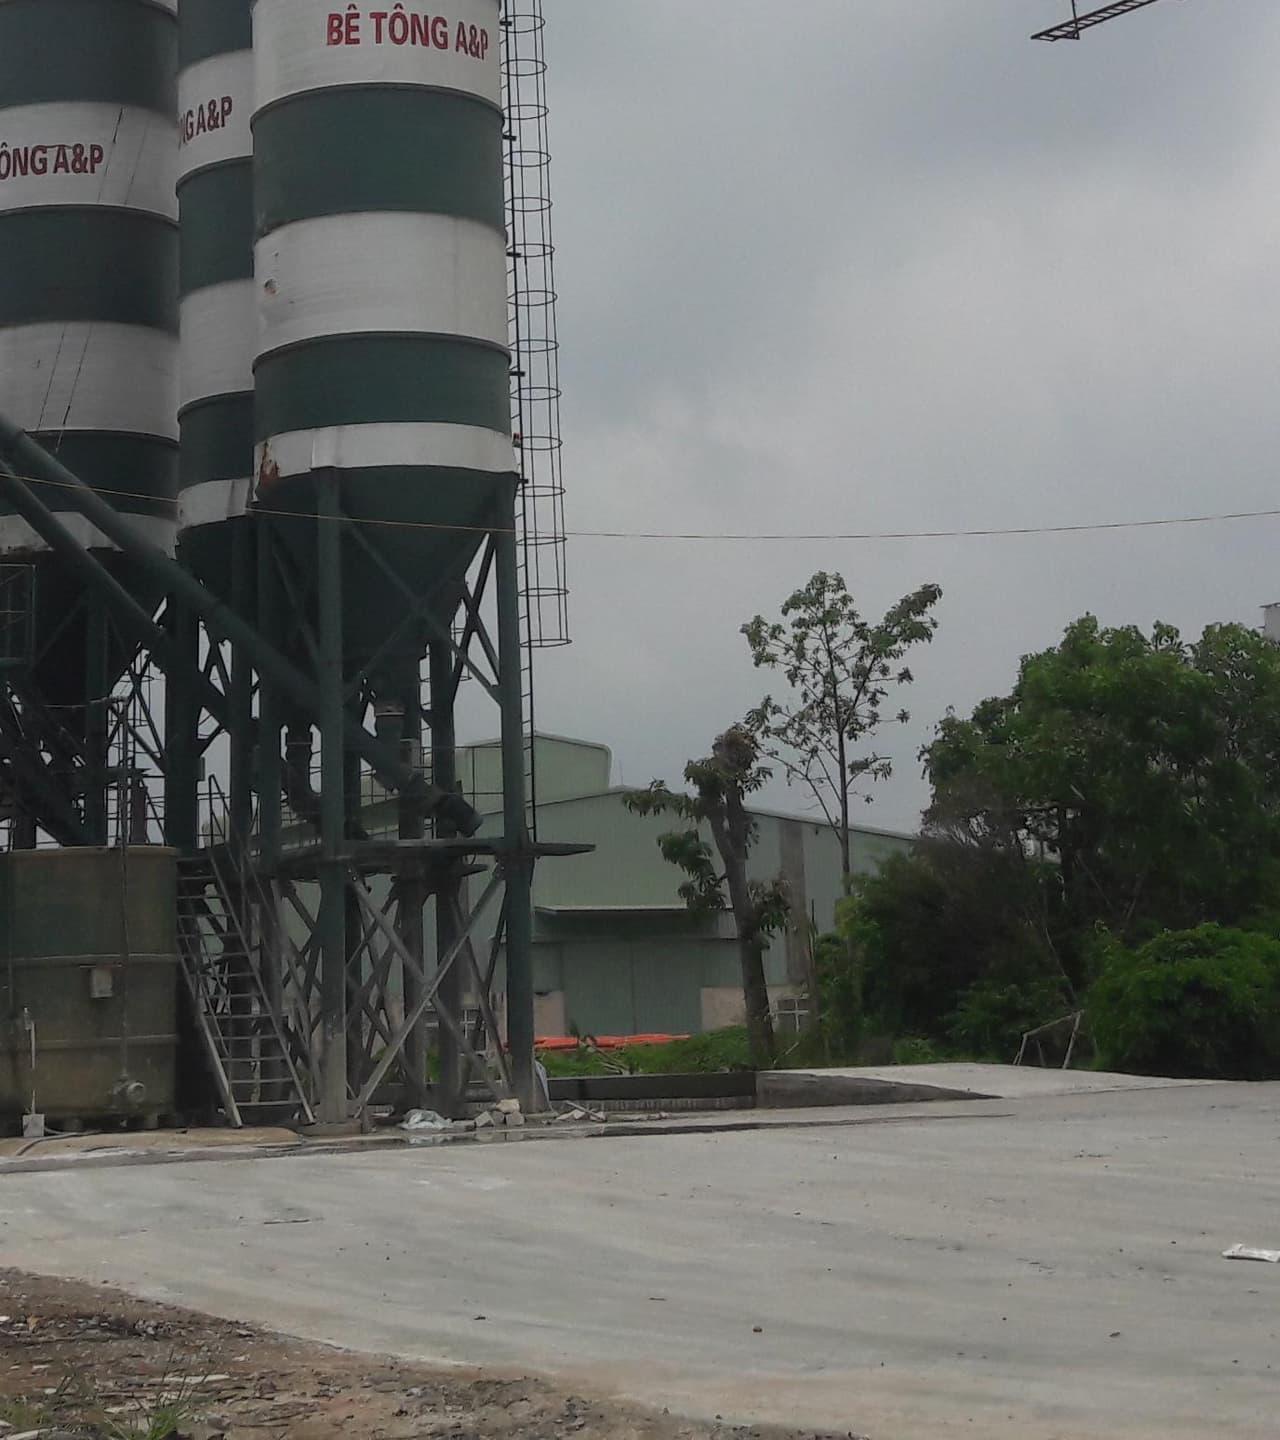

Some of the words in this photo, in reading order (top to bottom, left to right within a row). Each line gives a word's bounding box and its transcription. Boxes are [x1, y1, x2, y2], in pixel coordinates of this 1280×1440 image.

[326, 3, 361, 46] BÊ
[369, 2, 449, 50] TÔNG
[455, 21, 489, 61] A&P
[196, 95, 233, 136] A&P
[53, 143, 104, 175] A&P
